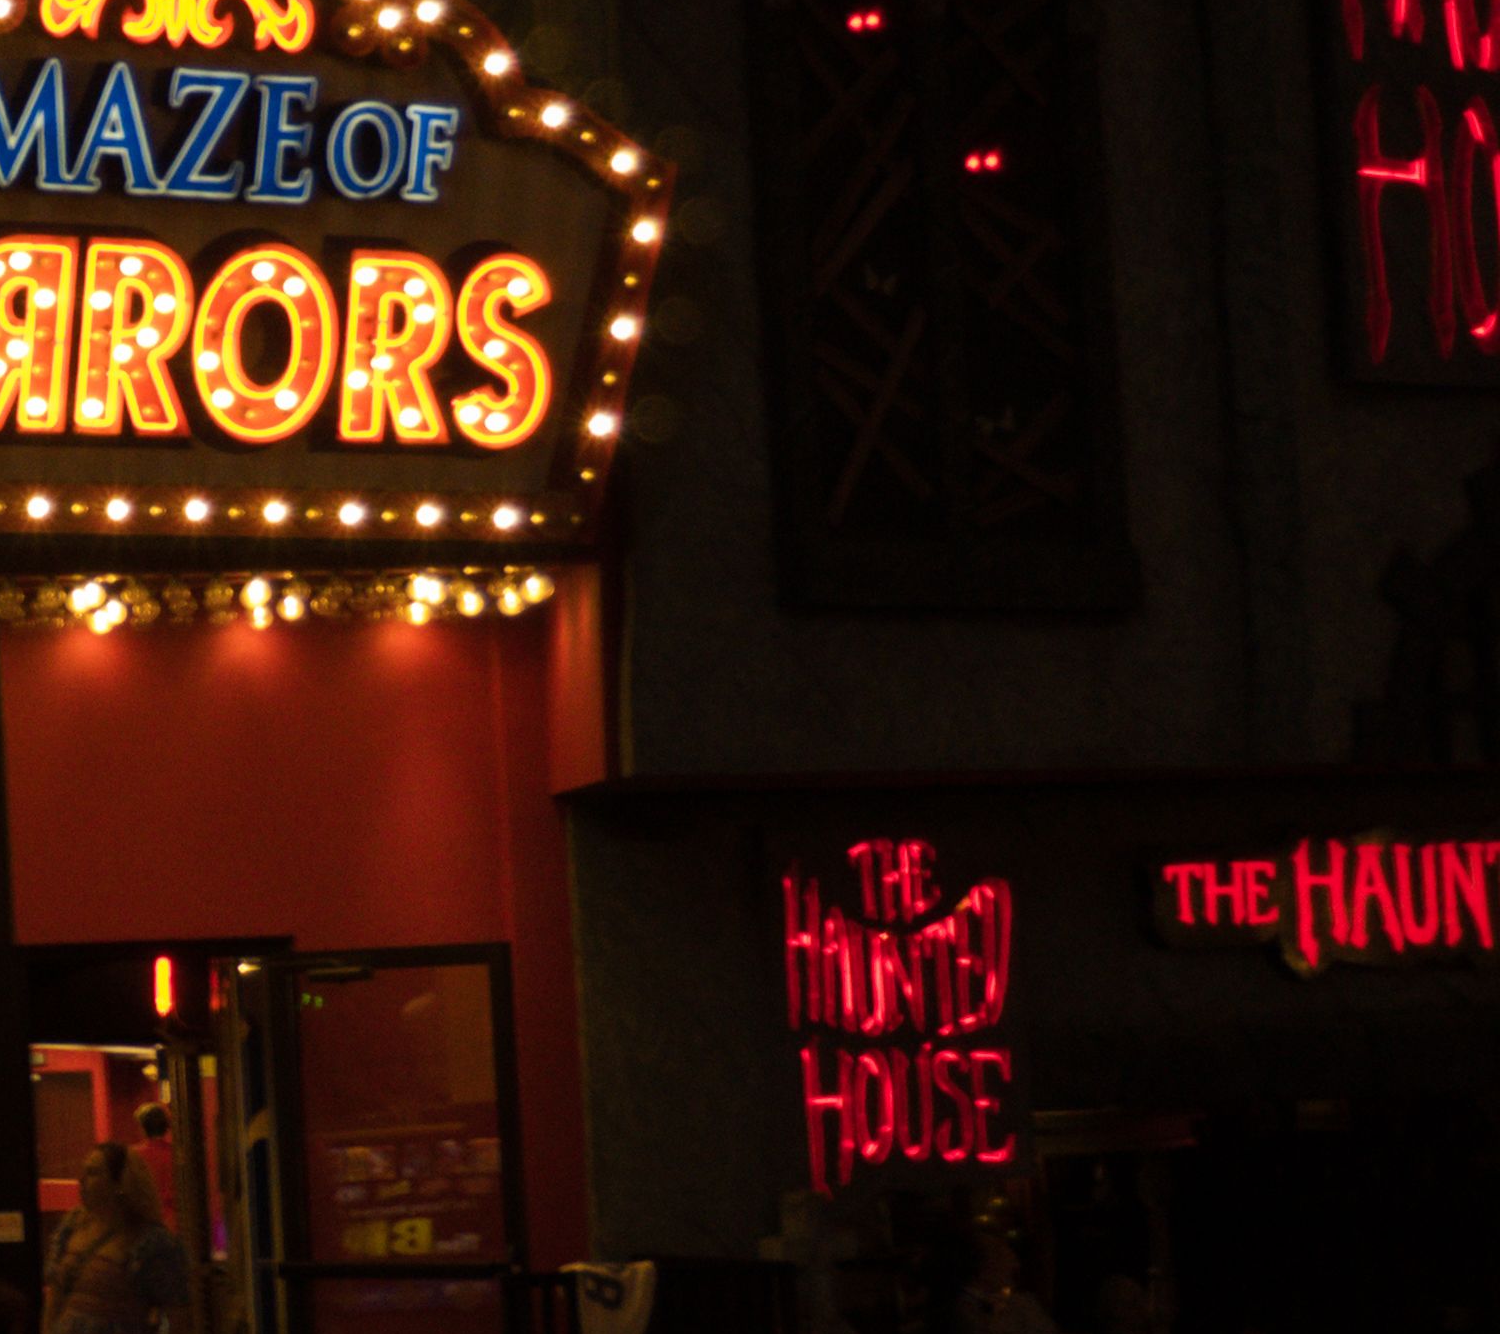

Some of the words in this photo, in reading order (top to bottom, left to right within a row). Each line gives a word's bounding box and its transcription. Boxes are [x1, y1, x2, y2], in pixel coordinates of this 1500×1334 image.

[327, 100, 458, 202] OF
[847, 838, 941, 924] THE
[1162, 859, 1279, 928] THE
[782, 863, 1012, 1036] HAUNTED
[799, 1039, 1016, 1199] HOUSE
